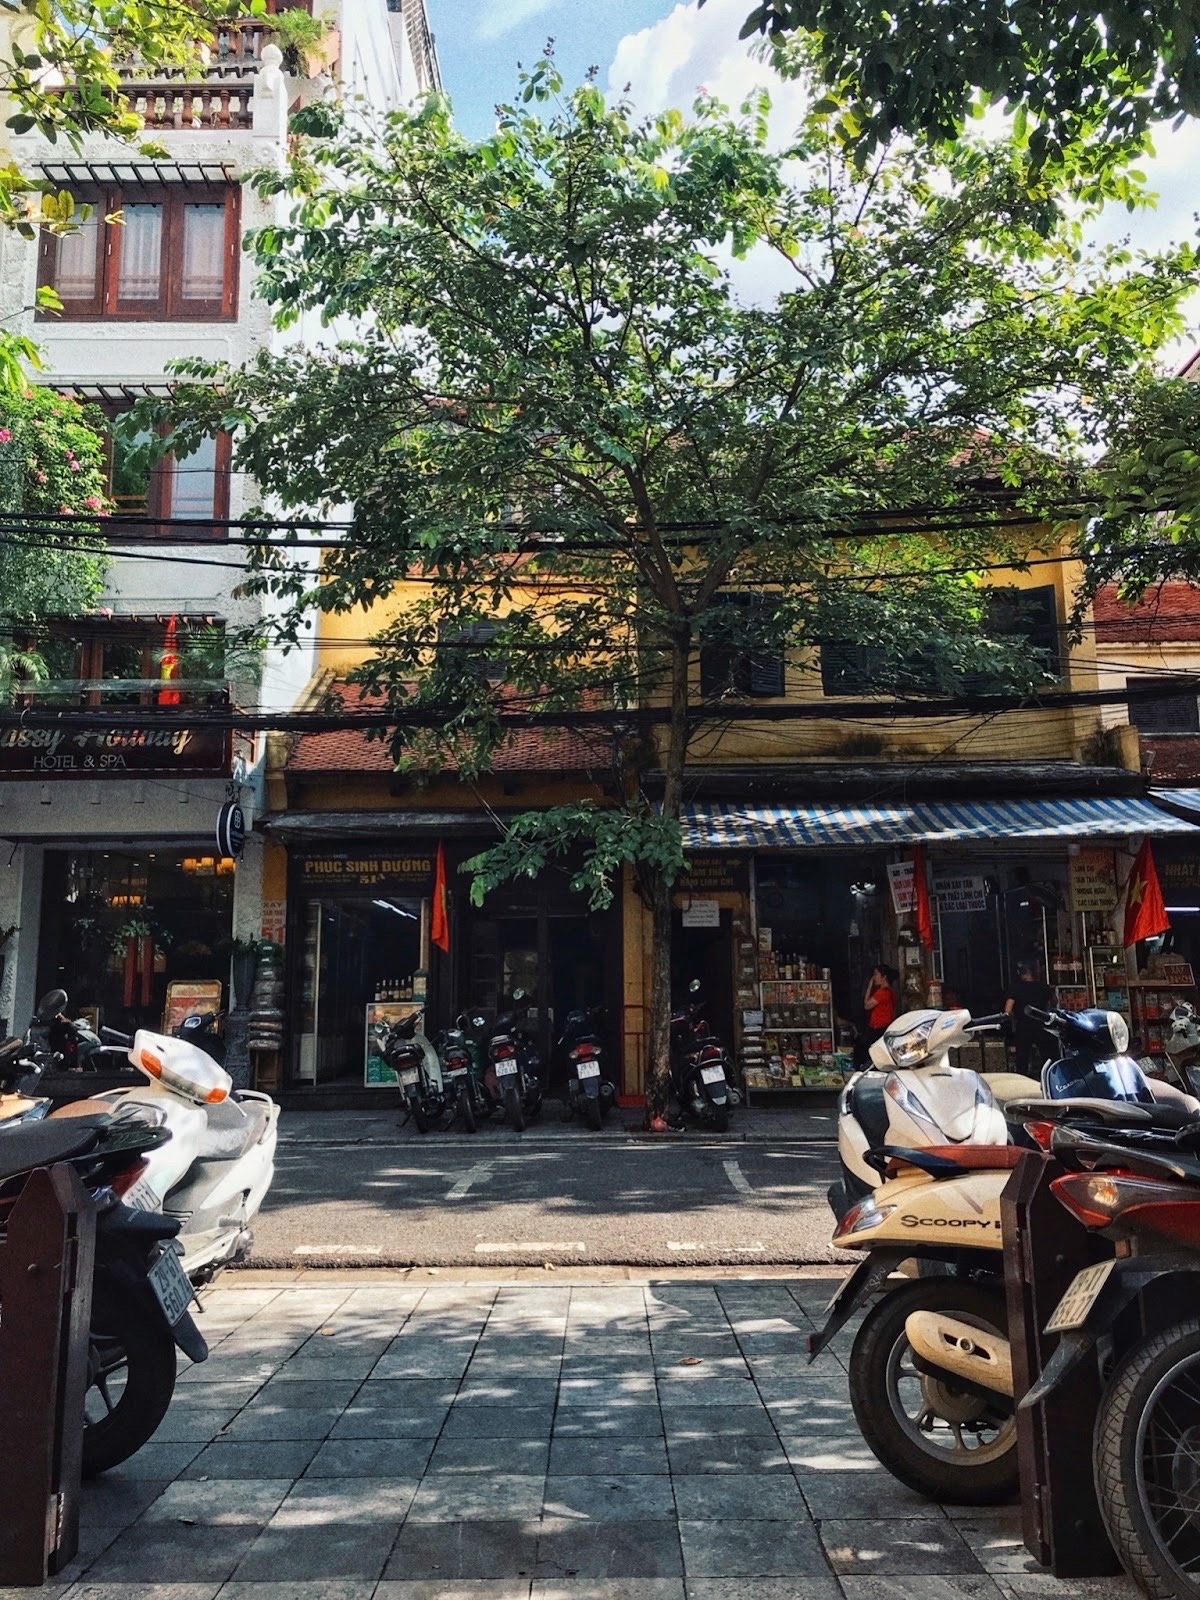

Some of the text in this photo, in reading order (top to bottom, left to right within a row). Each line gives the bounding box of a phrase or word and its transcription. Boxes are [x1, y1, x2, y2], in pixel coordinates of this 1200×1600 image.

[0, 728, 66, 755] assy
[33, 754, 126, 768] HOTEL & SPA
[345, 860, 379, 872] SINH
[263, 901, 283, 909] XAY
